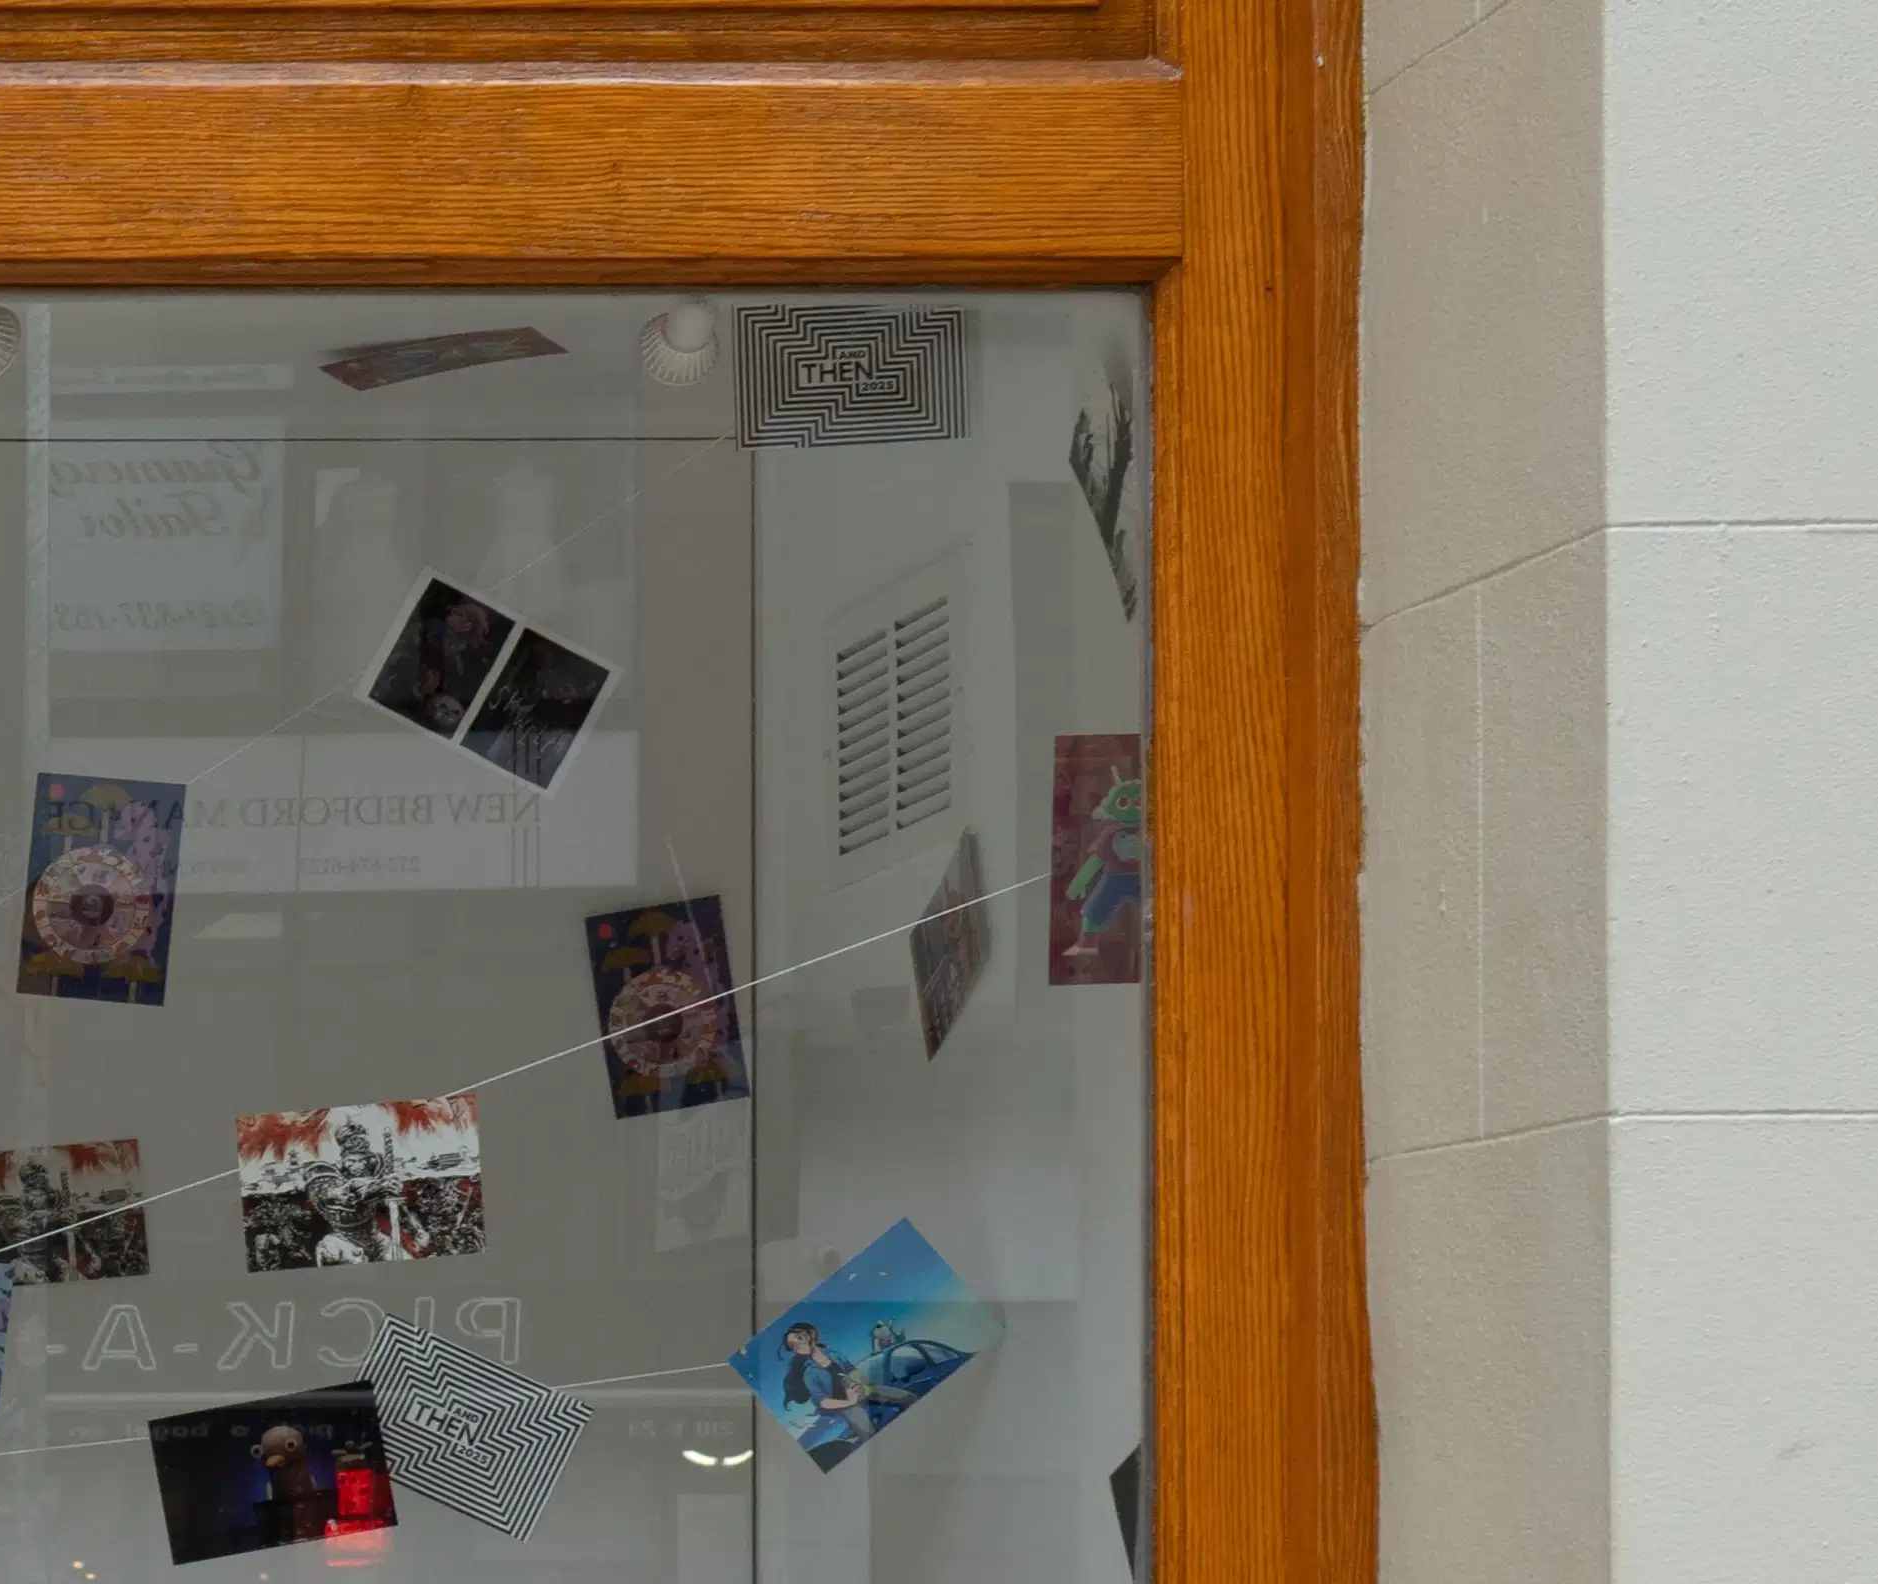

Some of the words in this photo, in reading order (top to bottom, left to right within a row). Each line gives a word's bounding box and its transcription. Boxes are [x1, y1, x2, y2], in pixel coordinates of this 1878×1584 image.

[801, 361, 875, 384] THEN
[415, 1401, 478, 1446] THEN
[452, 1407, 481, 1424] AND
[457, 1445, 489, 1464] 2025
